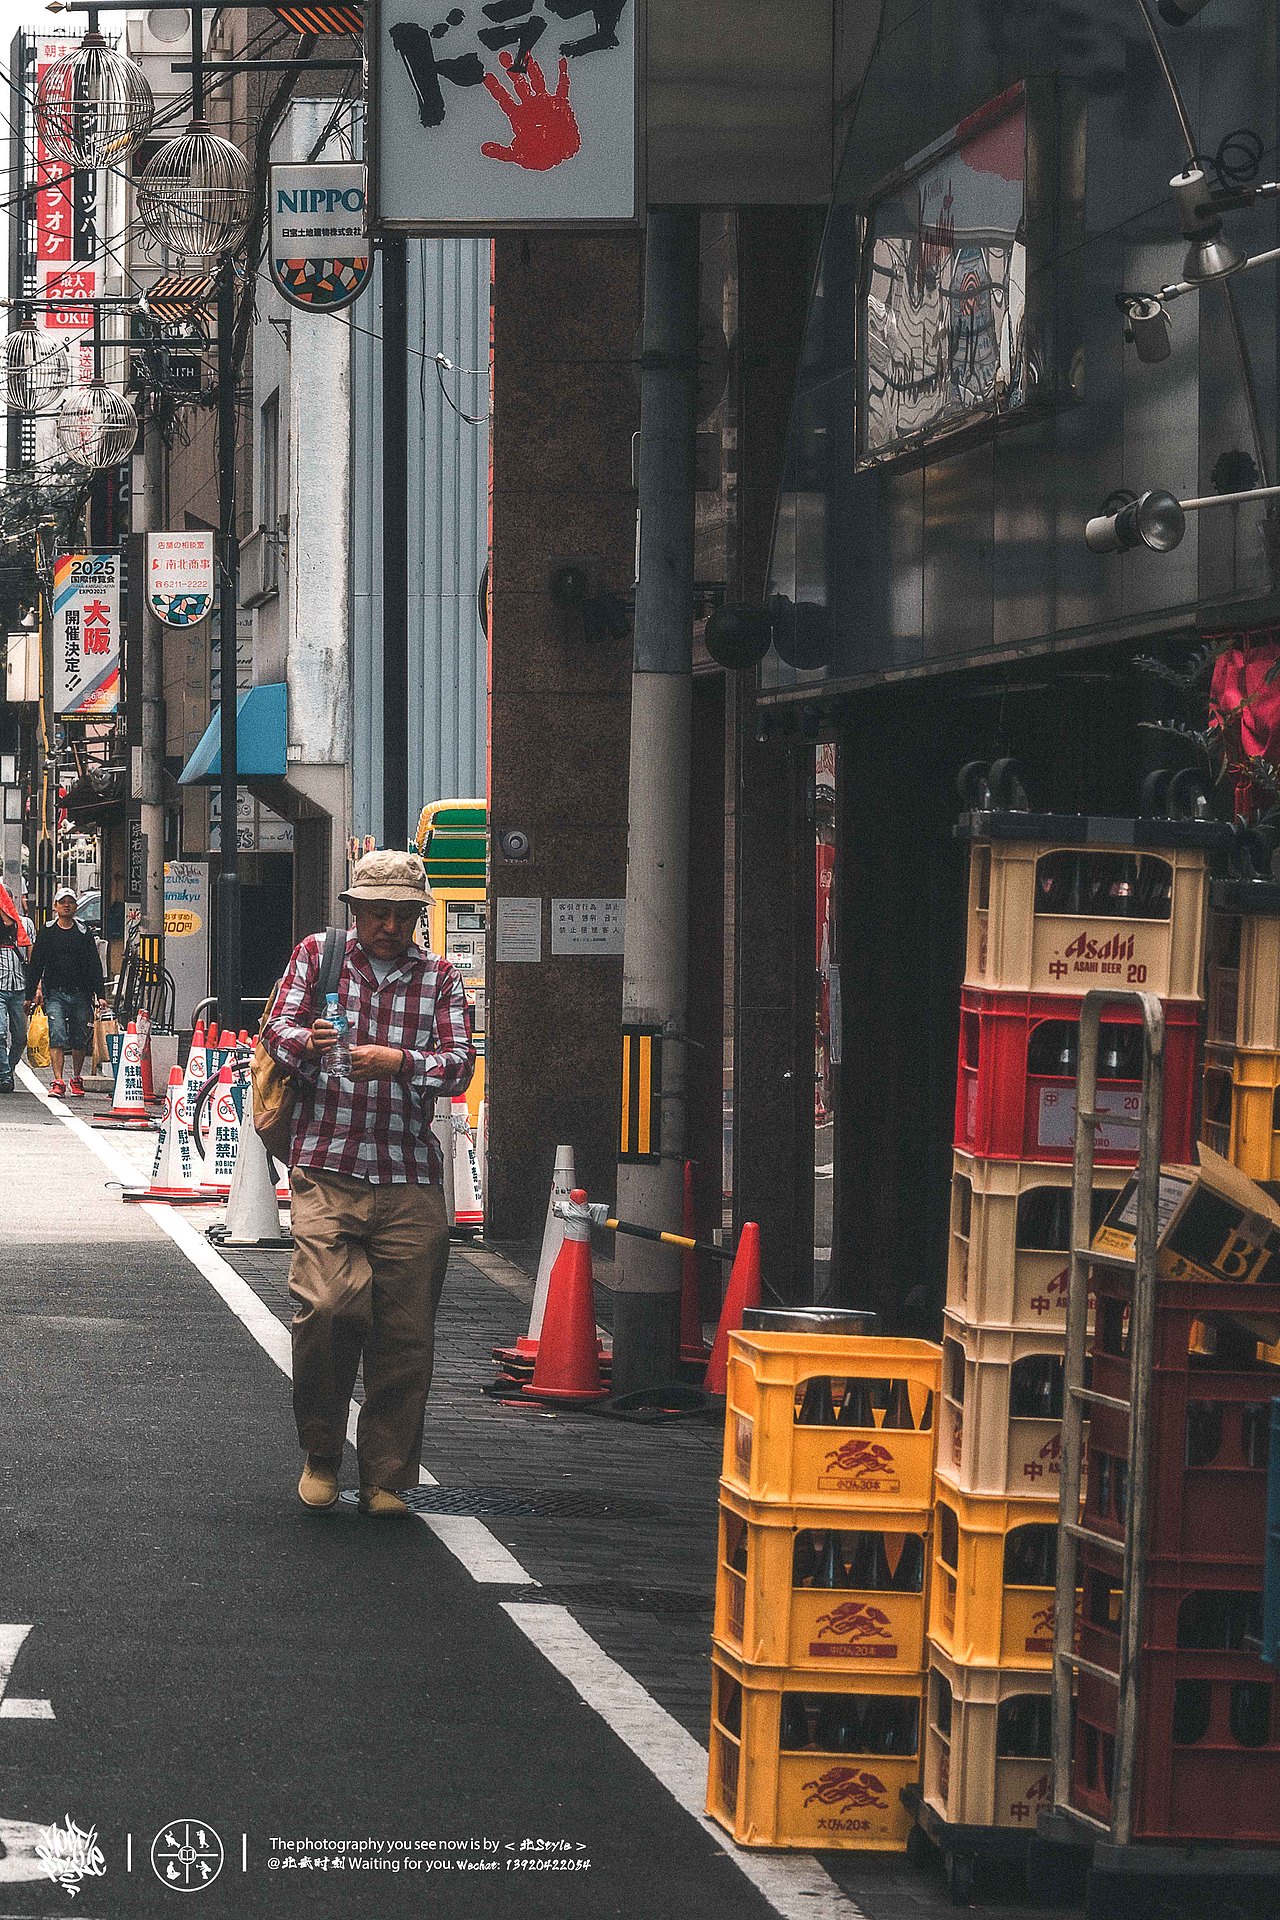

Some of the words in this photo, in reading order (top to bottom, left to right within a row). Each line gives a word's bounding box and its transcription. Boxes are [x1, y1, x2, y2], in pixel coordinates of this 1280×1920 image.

[277, 188, 364, 214] NIPPO
[70, 561, 116, 576] 2025
[165, 558, 211, 570] 南北商事
[70, 575, 116, 584] 国際博覧会
[83, 599, 111, 655] 大阪
[1064, 931, 1135, 961] Asahi
[1048, 959, 1069, 980] 中
[1073, 961, 1099, 973] ASAHI
[1101, 962, 1122, 974] BEER
[1126, 963, 1147, 983] 20
[1123, 1097, 1140, 1110] 20
[1030, 1295, 1050, 1316] 中
[1024, 1461, 1043, 1481] 中
[1010, 1802, 1030, 1822] 中
[817, 1817, 871, 1831] 大びん20本
